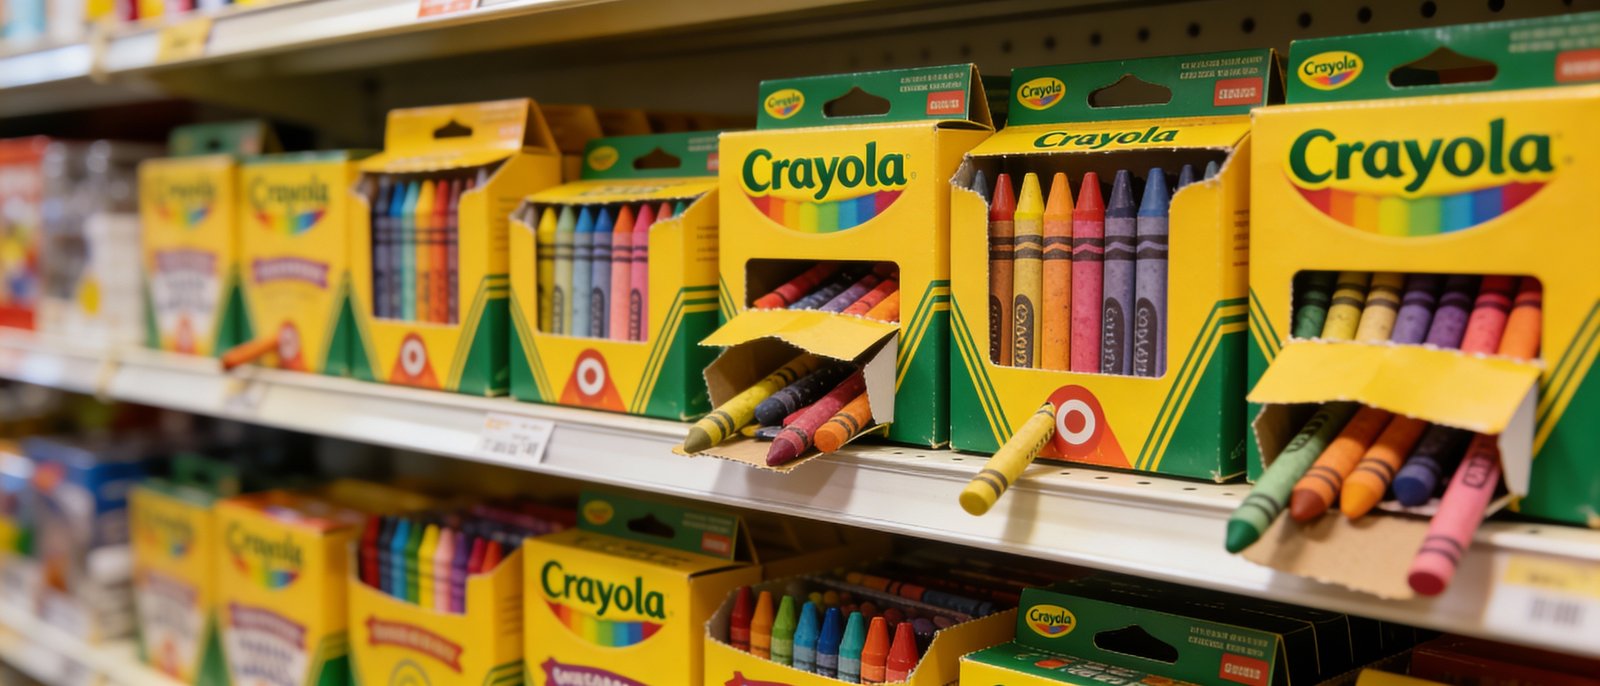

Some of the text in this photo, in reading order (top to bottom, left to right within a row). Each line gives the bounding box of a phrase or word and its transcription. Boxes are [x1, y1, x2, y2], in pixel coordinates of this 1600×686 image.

[1303, 55, 1357, 77] Crayola
[1021, 83, 1061, 98] Crayola
[1033, 126, 1180, 149] Crayola
[1289, 117, 1555, 192] Crayola
[742, 141, 907, 200] Crayola
[541, 560, 666, 619] Crayola
[1030, 609, 1072, 627] Crayola
